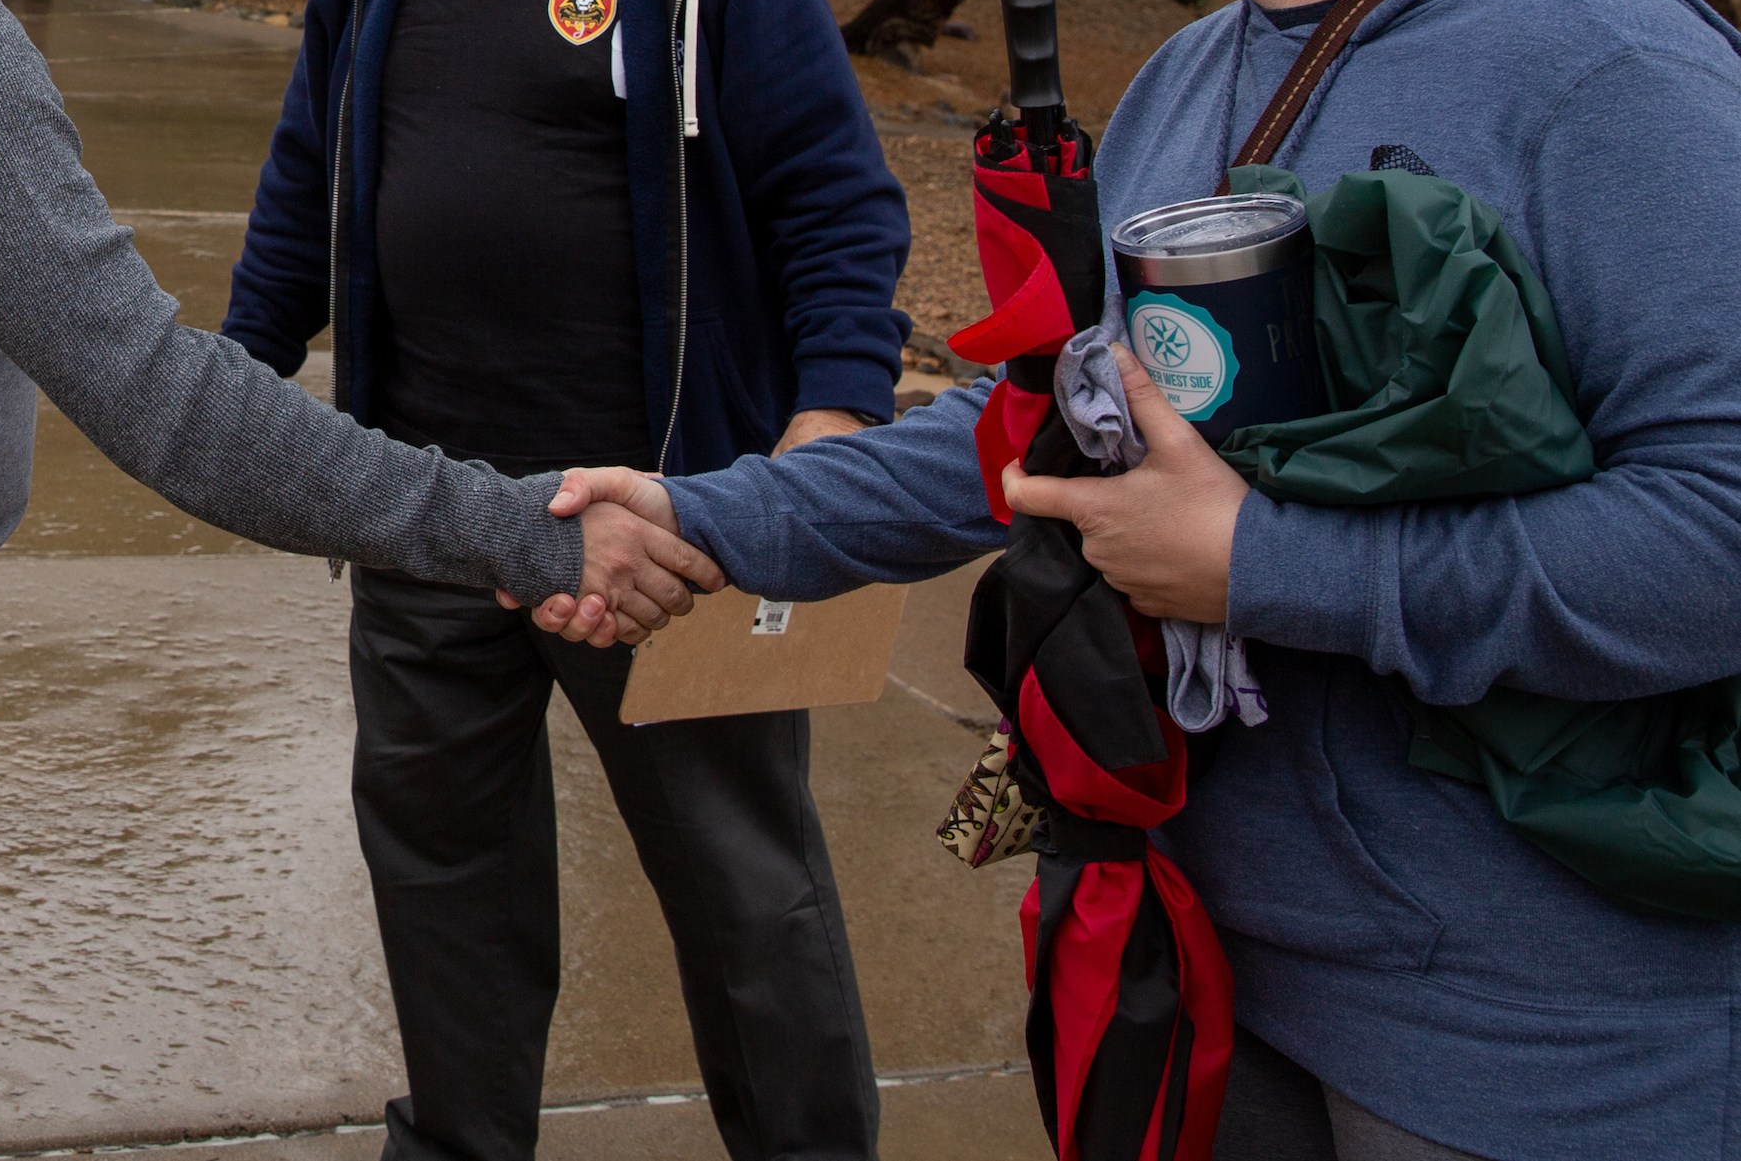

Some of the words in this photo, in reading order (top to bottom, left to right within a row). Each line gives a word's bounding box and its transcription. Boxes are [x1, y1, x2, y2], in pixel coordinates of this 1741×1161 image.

[1163, 373, 1187, 388] WEST
[1189, 376, 1213, 389] SIDE
[1168, 393, 1181, 403] PHX
